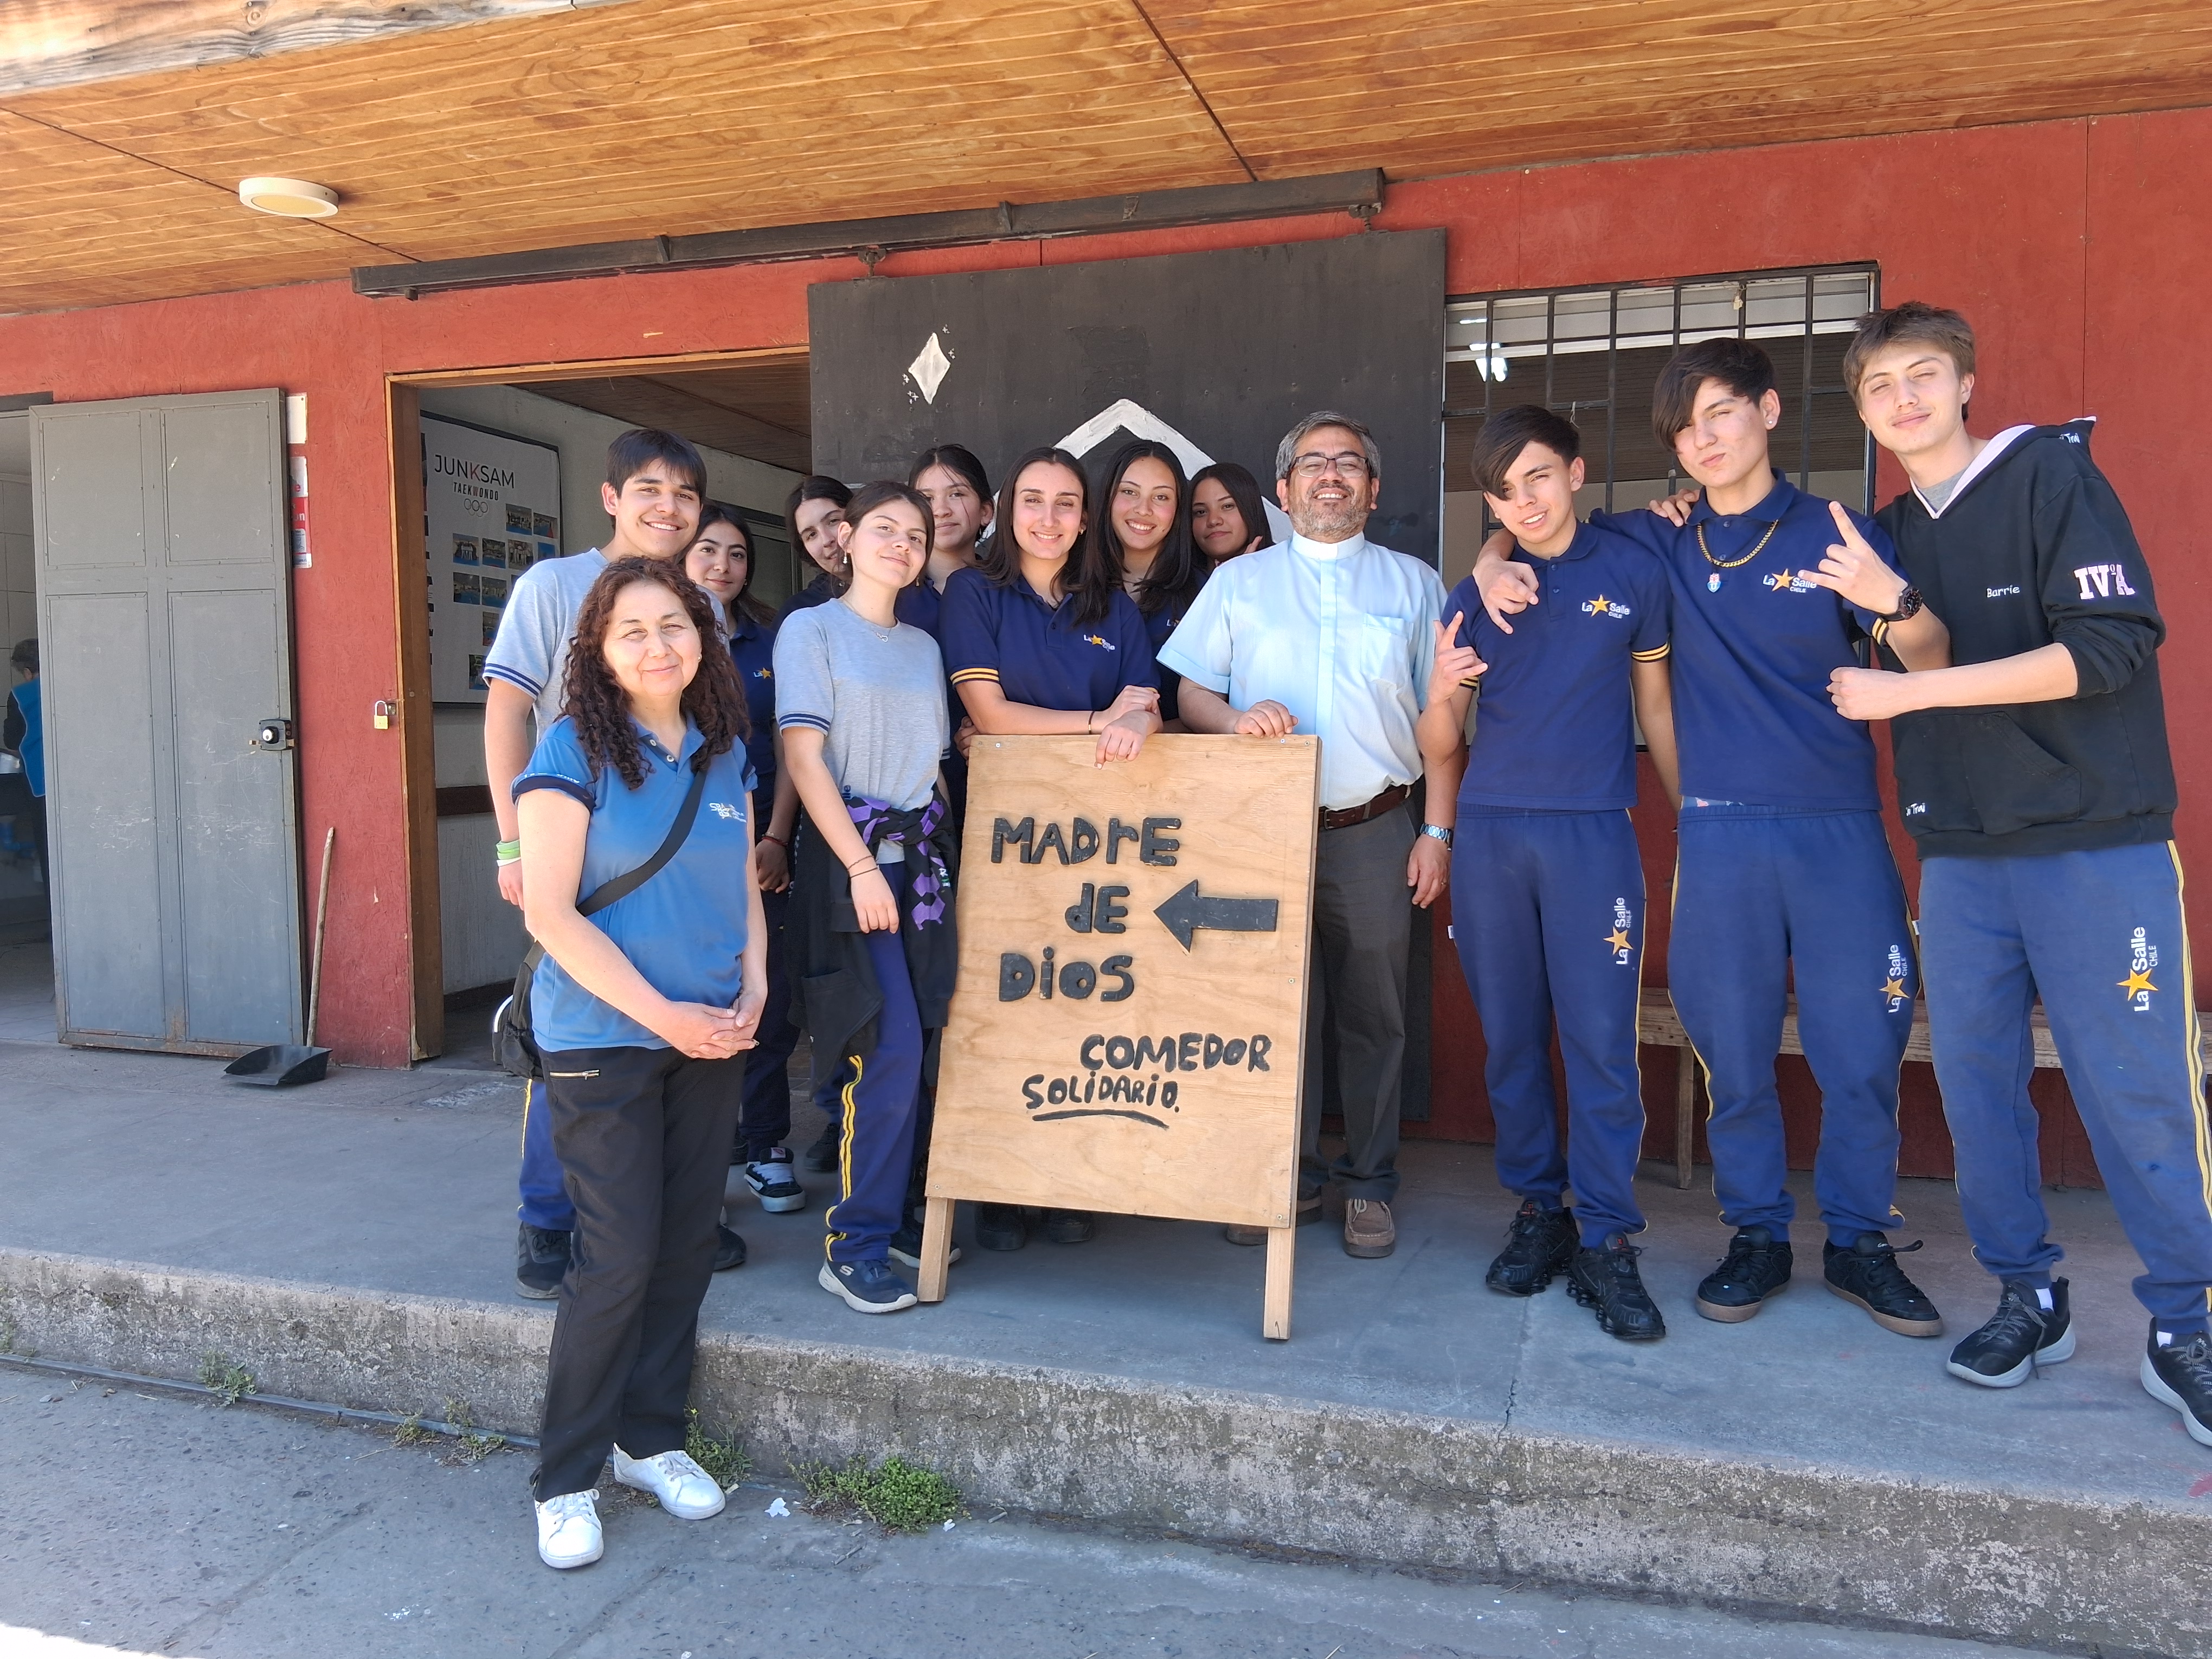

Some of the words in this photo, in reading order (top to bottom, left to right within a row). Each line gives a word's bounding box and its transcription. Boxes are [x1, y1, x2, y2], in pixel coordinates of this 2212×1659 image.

[434, 454, 515, 488] JUNKSAM
[453, 482, 499, 501] TAEKWONDO
[1763, 574, 1775, 586] La
[1792, 577, 1817, 589] Salle
[1986, 584, 2021, 598] Barrie
[1581, 602, 1593, 612] La
[1609, 602, 1630, 615] Salle
[1614, 897, 1626, 928] Salle
[1616, 949, 1629, 964] La
[2131, 927, 2147, 971] Salle
[2148, 945, 2158, 967] CHILE
[1888, 944, 1901, 976] Salle
[1888, 997, 1902, 1013] La
[2134, 991, 2149, 1012] La
[1081, 1032, 1272, 1072] COMEDOR
